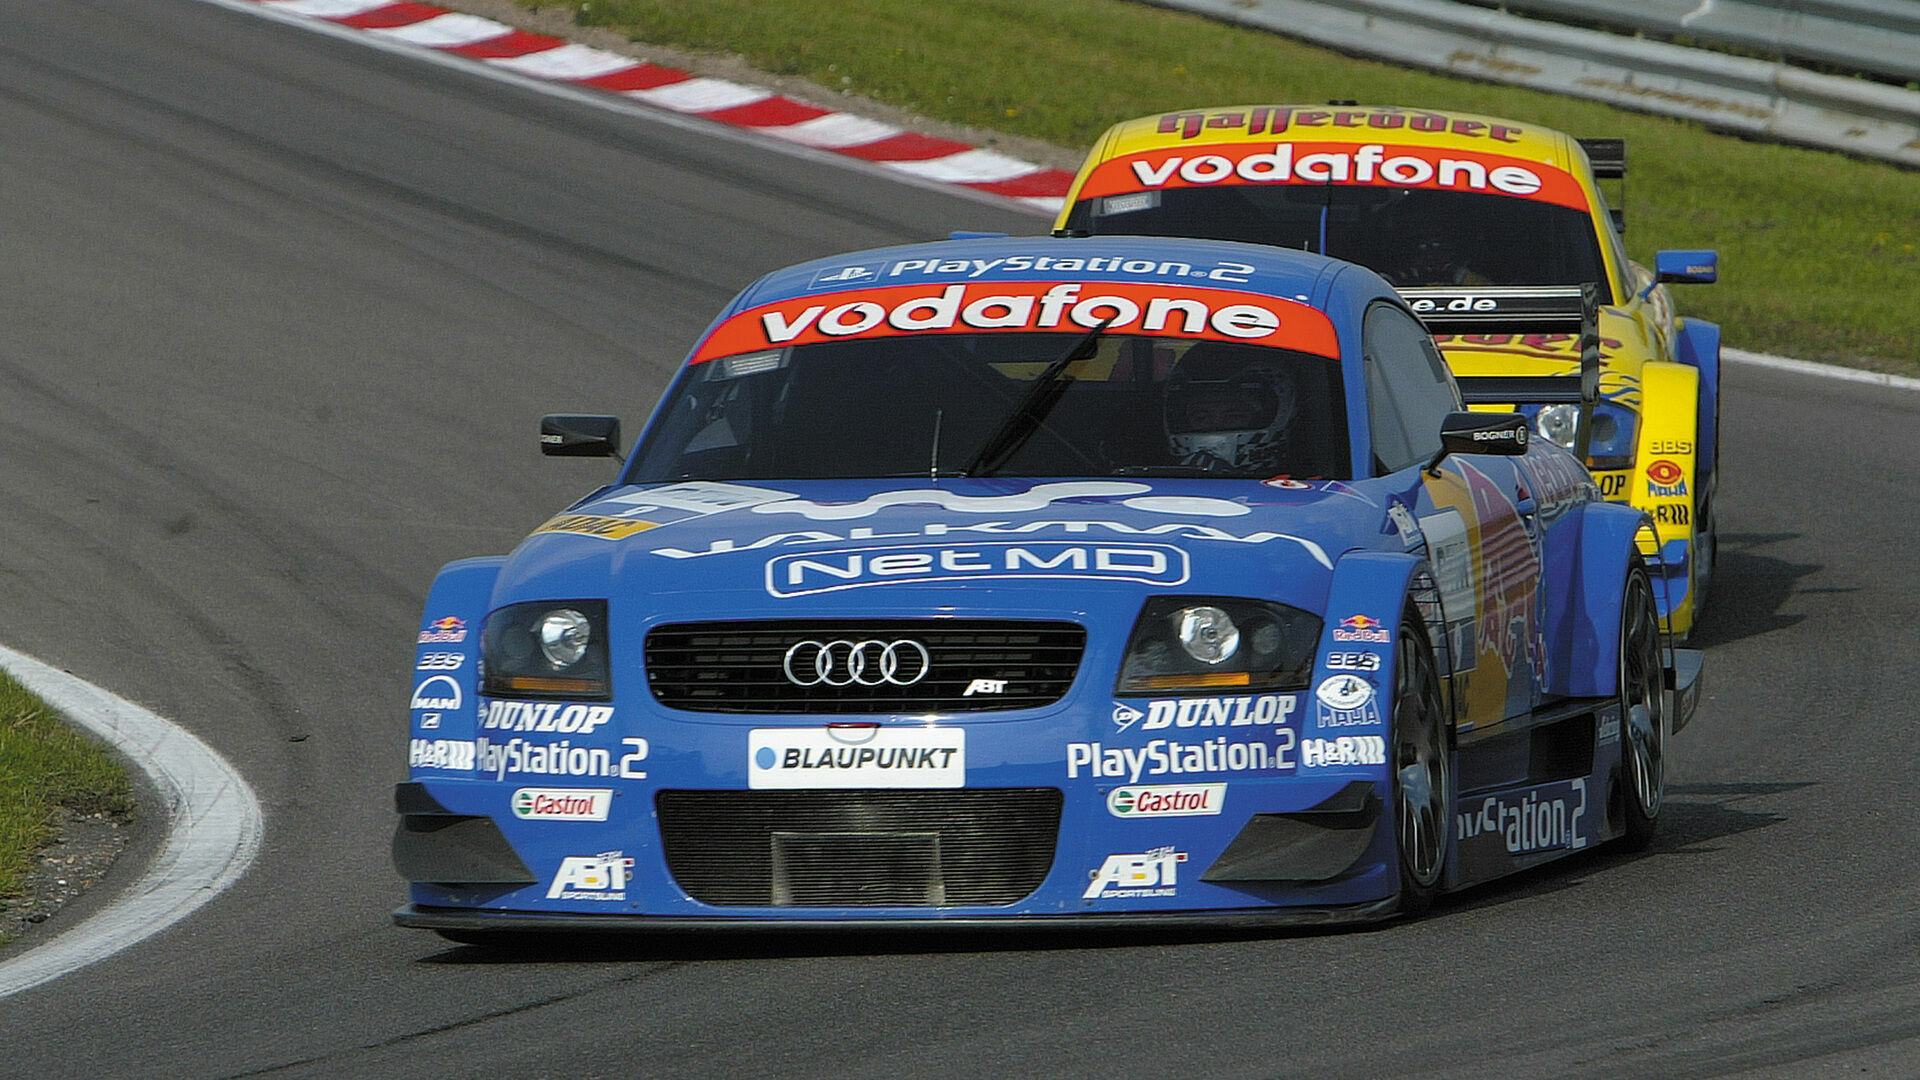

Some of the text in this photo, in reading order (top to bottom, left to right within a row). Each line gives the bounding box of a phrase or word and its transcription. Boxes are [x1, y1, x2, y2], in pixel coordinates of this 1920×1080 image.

[1131, 144, 1543, 195] vodafone
[760, 283, 1281, 342] vodafone
[1404, 297, 1498, 311] e.de
[1473, 430, 1515, 441] BOGNER
[1649, 440, 1692, 455] BBS
[1600, 475, 1626, 495] OP
[1332, 629, 1391, 642] Red Bull
[1326, 652, 1381, 671] BBS
[963, 679, 1008, 695] ABT
[415, 698, 457, 709] MAN
[1141, 695, 1297, 730] DUNLOP
[485, 701, 615, 733] DUNLOP
[782, 747, 957, 769] BLAUPUNKT
[1066, 737, 1268, 783] PlayStation
[1301, 738, 1357, 767] H&R
[534, 795, 595, 815] Castrol
[1137, 788, 1209, 812] Castrol
[546, 856, 635, 899] ABT
[1082, 852, 1188, 898] ABT
